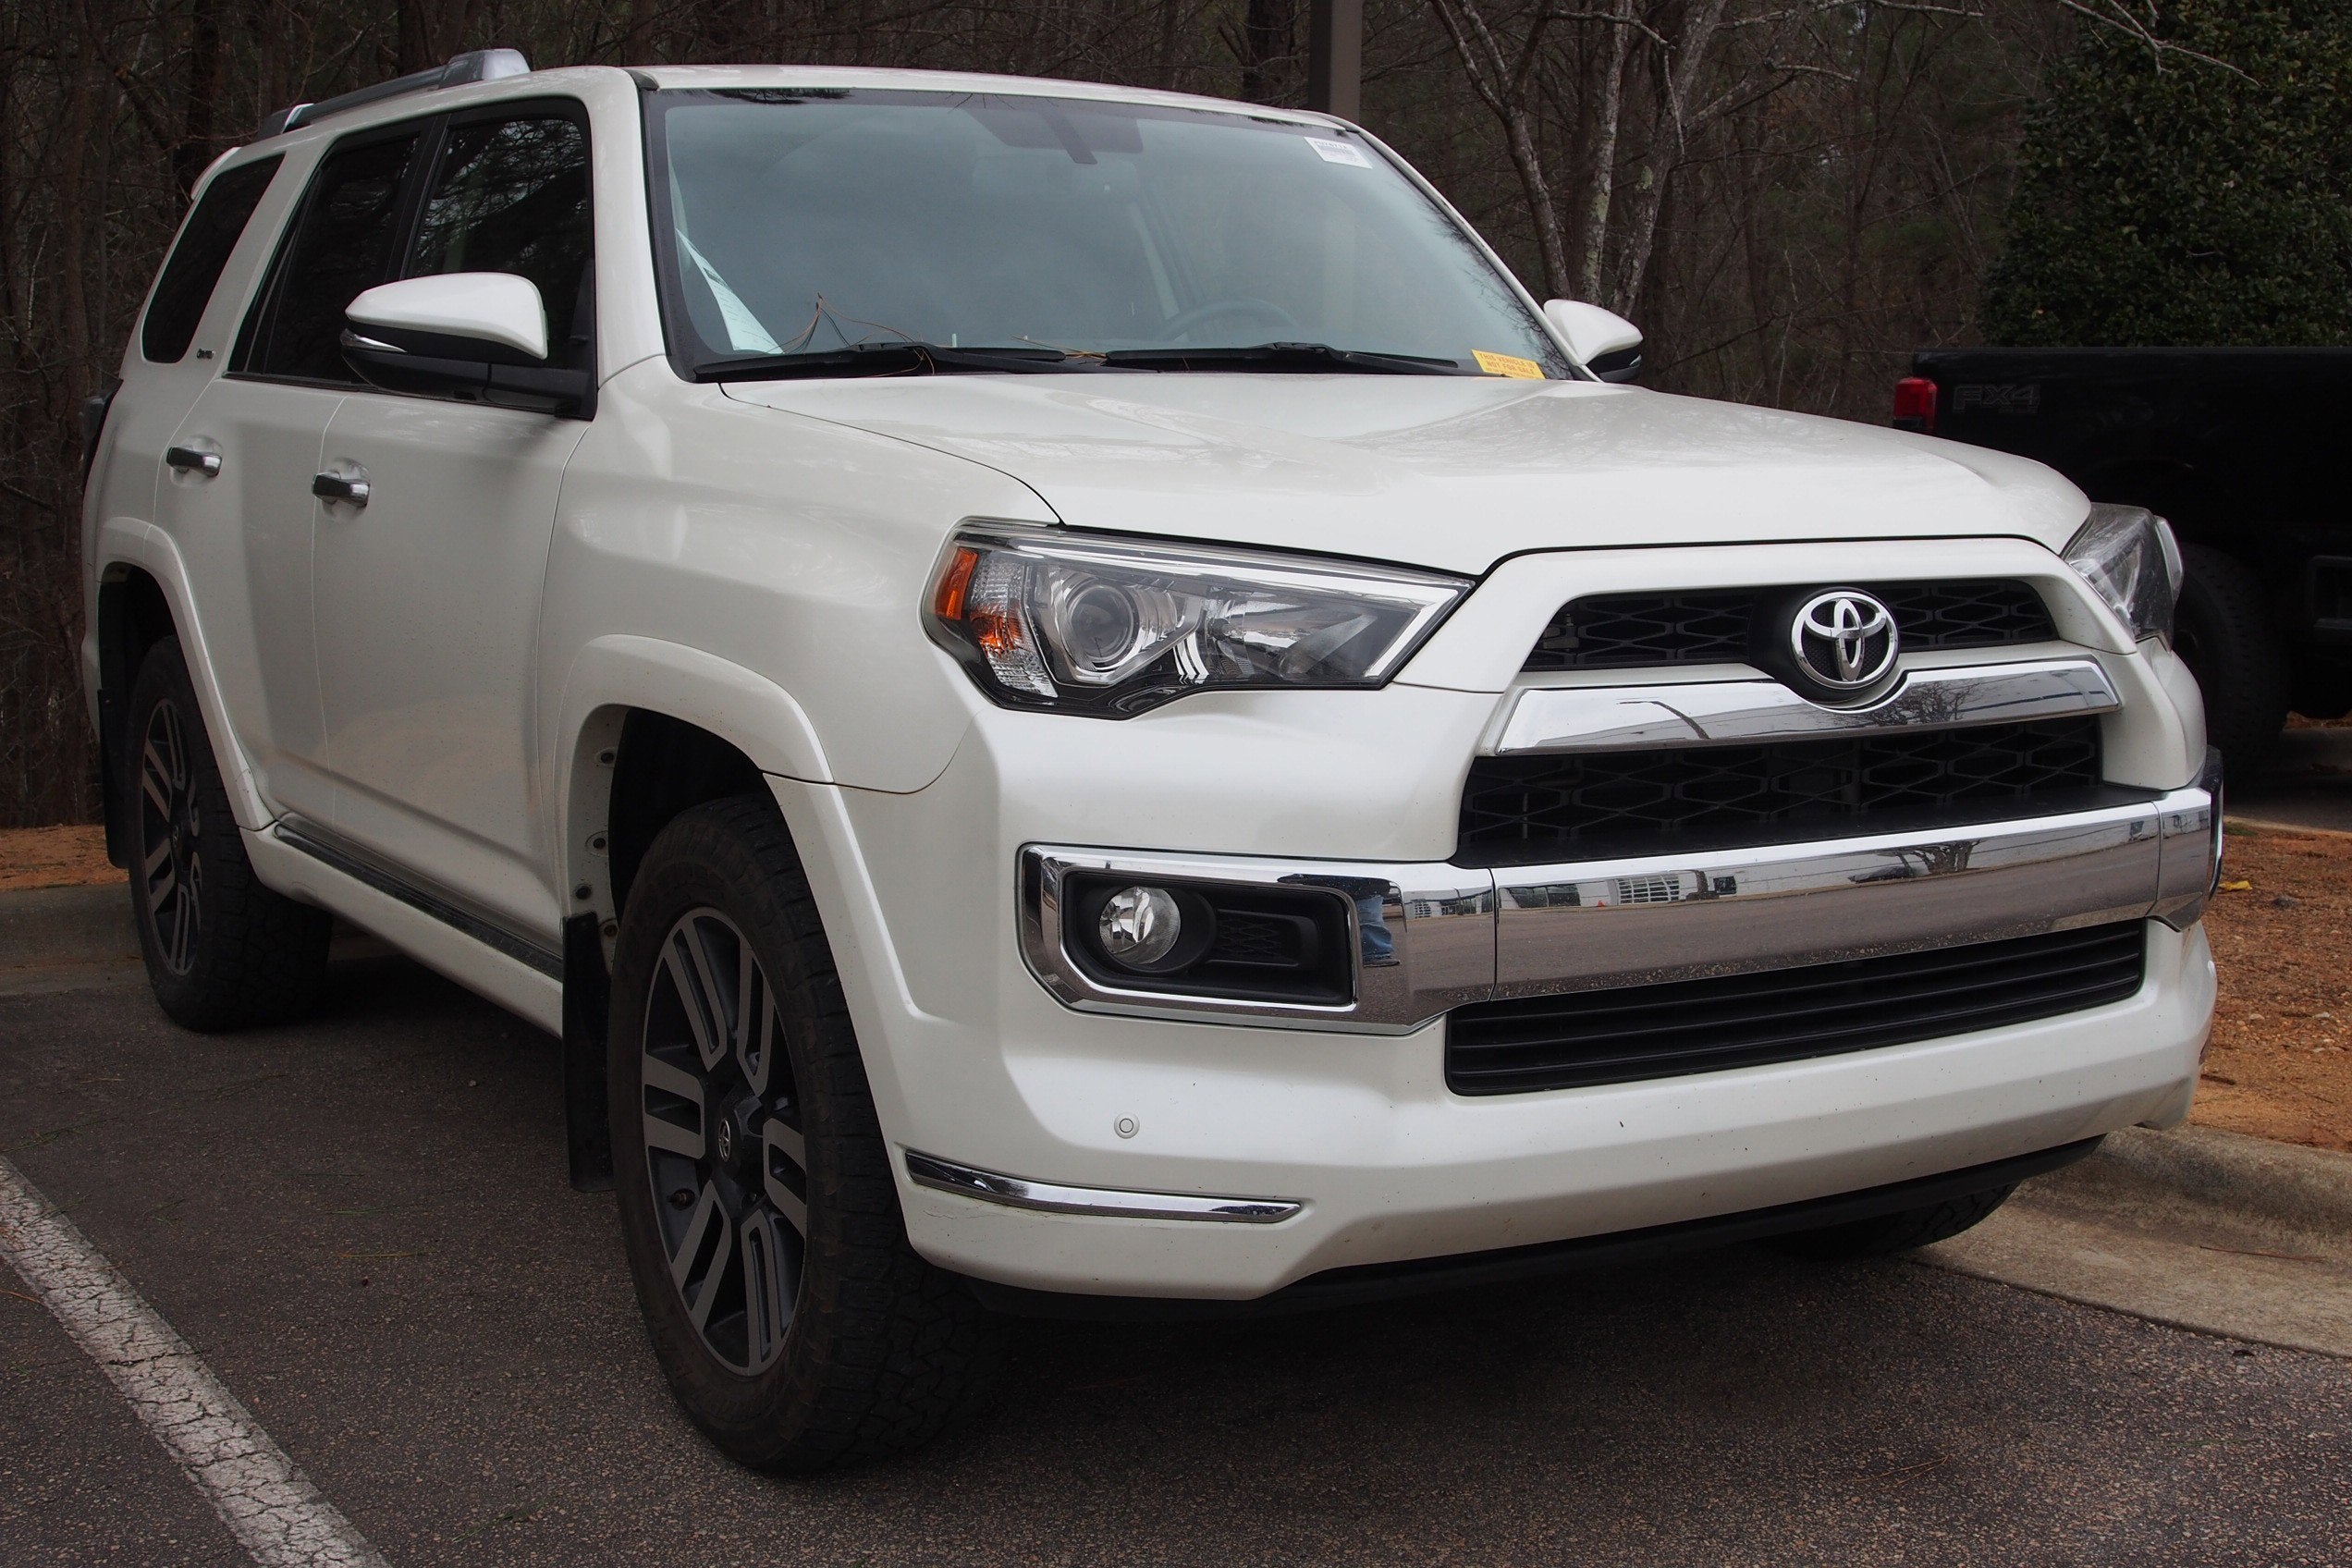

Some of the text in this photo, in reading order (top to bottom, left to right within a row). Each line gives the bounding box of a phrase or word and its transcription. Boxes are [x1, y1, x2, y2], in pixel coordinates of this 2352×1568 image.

[1479, 353, 1496, 361] THIS
[1497, 356, 1525, 366] VEHICLE
[1953, 385, 2040, 410] FX4
